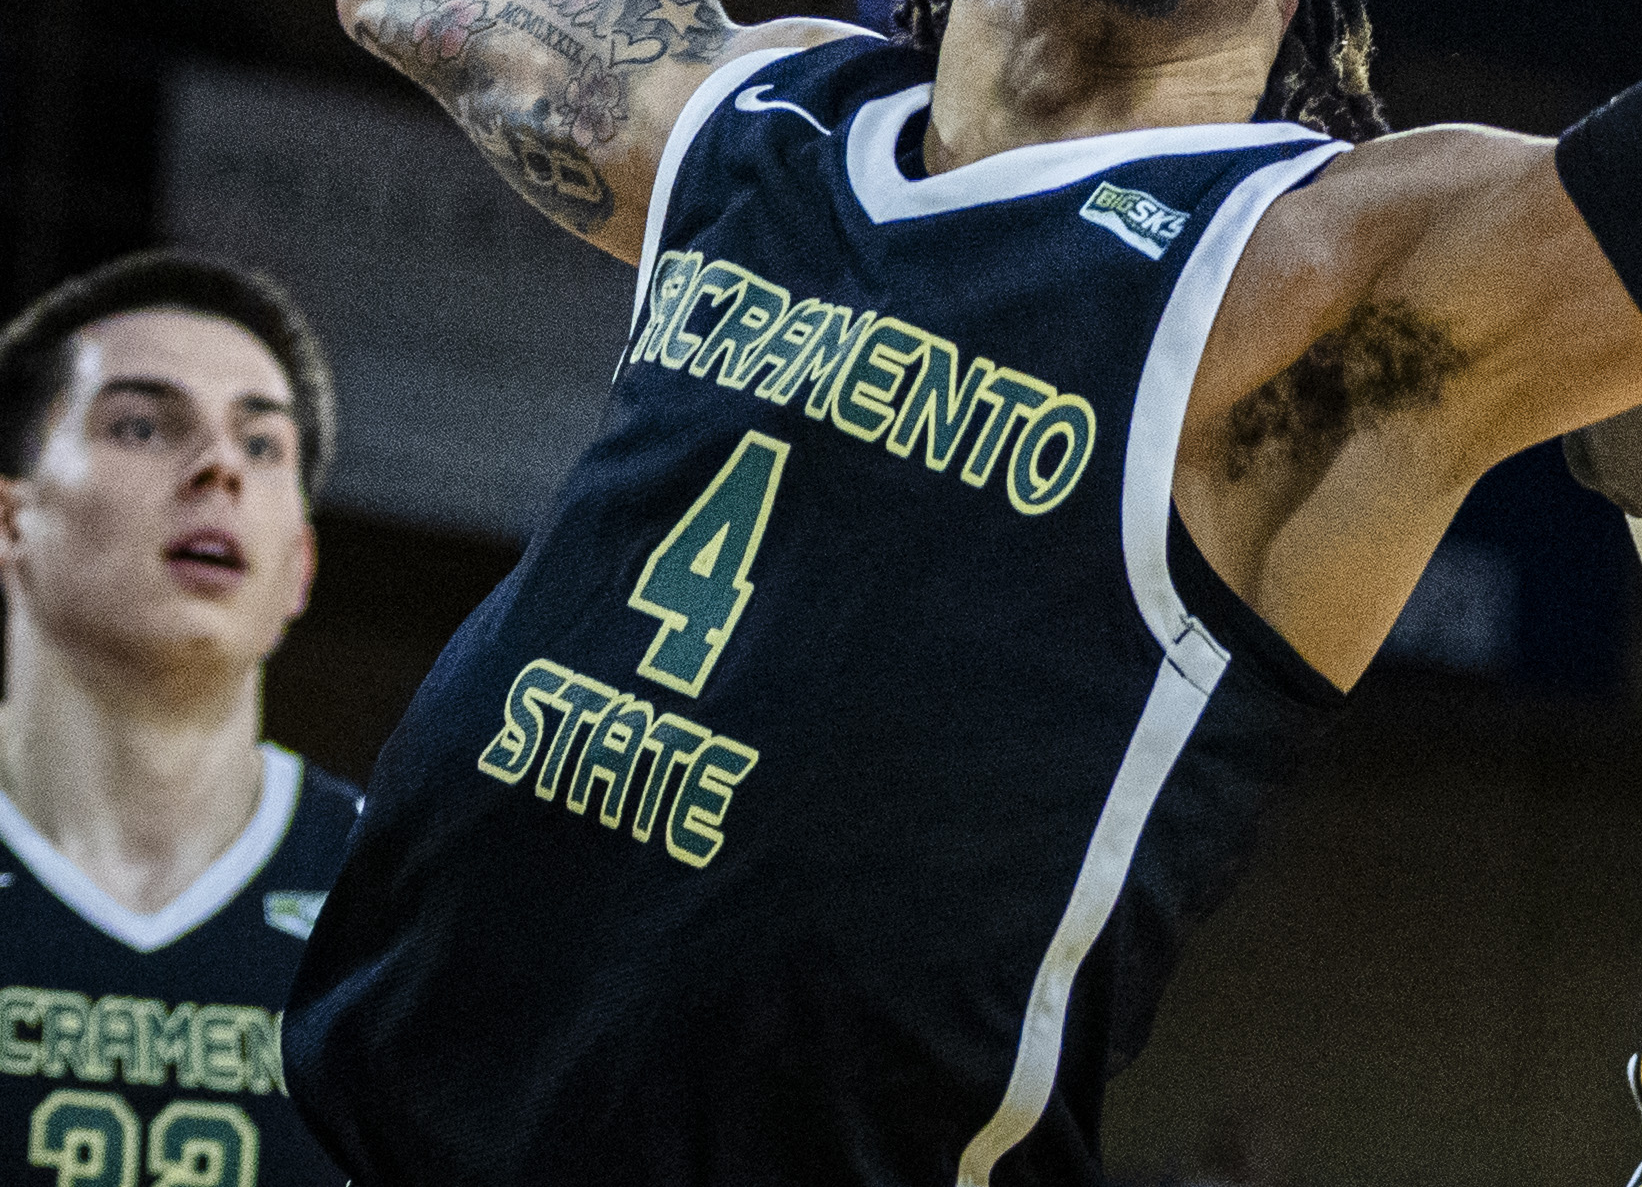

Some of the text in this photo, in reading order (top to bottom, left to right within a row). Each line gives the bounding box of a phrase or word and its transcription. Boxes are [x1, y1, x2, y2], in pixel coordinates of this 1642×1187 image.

[630, 249, 1096, 516] ACRAMENTO
[628, 429, 791, 698] 4
[476, 658, 760, 869] STATE
